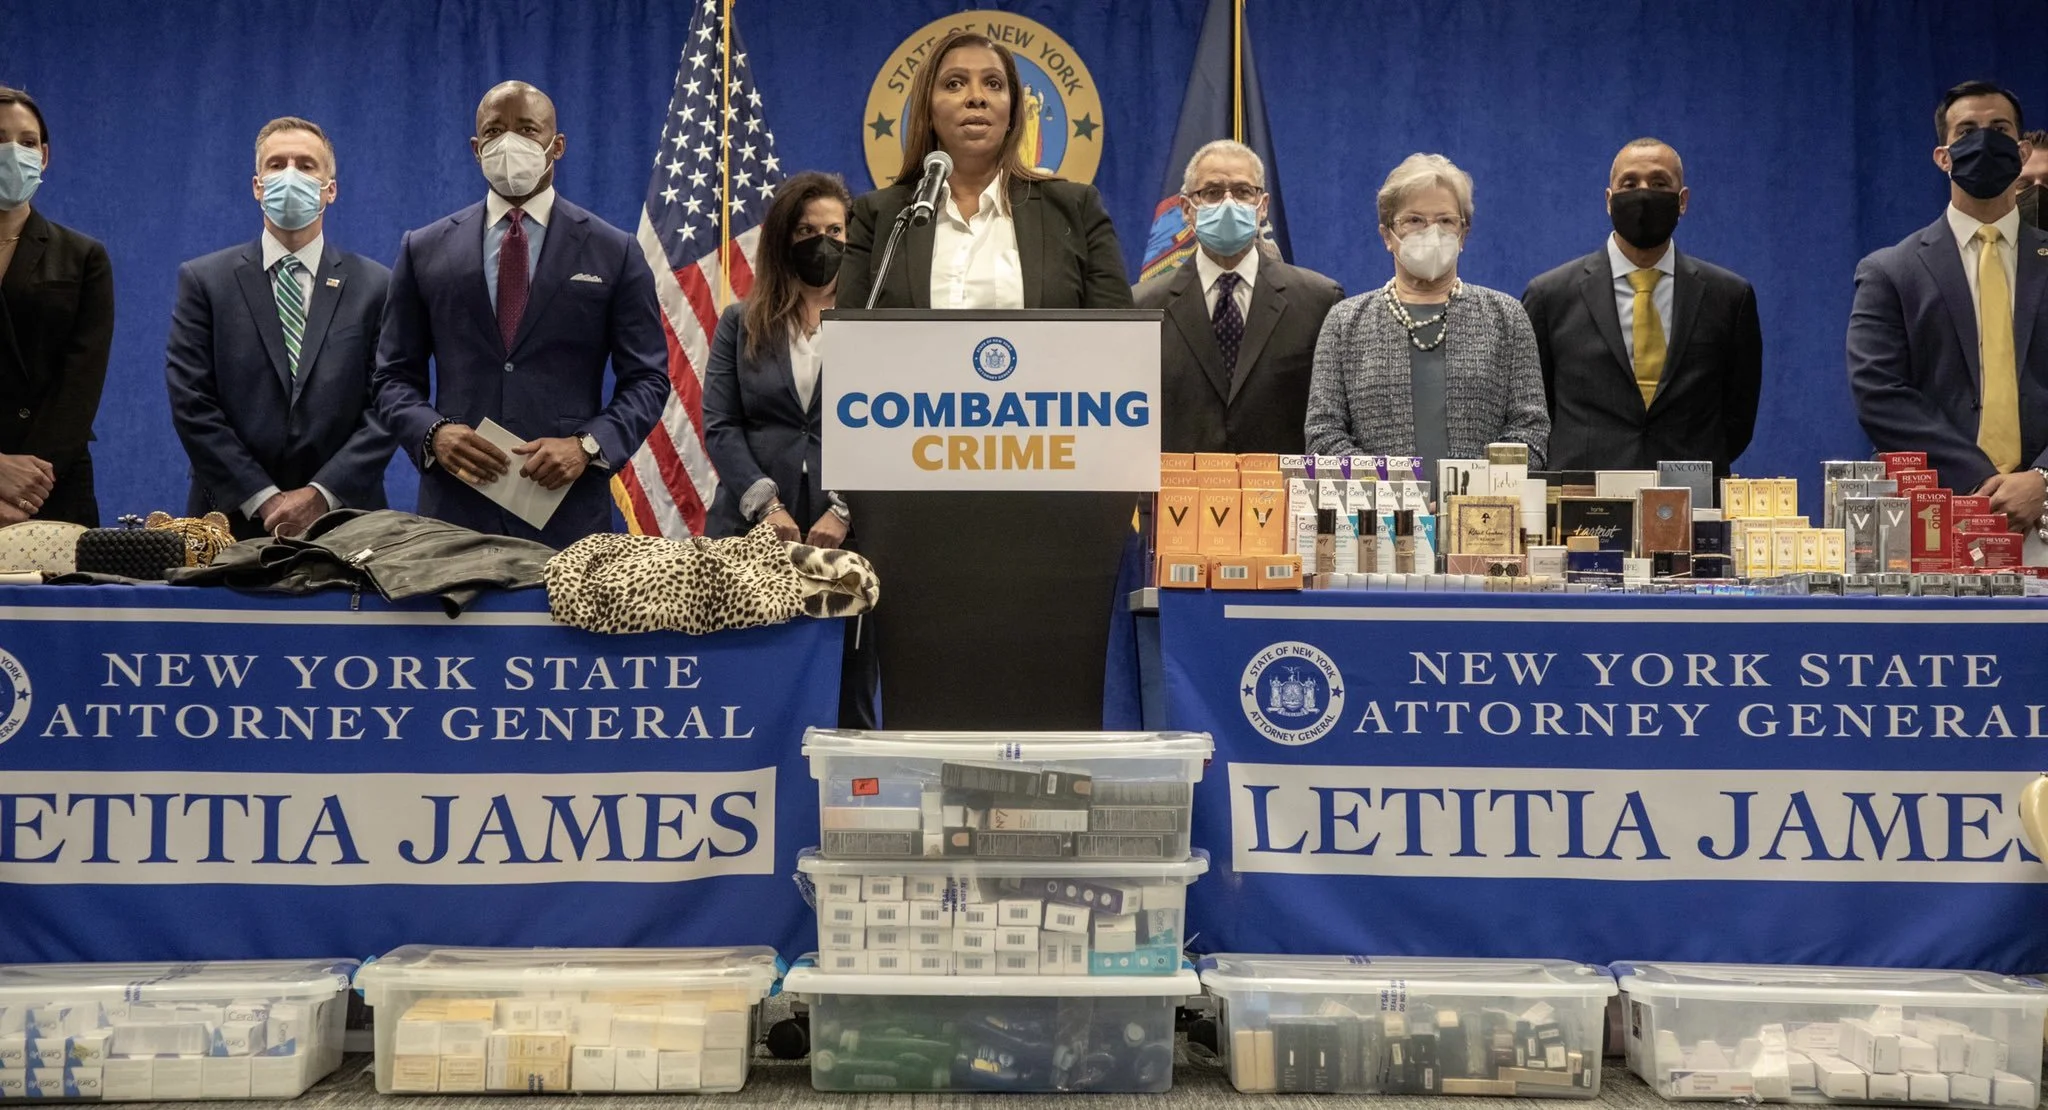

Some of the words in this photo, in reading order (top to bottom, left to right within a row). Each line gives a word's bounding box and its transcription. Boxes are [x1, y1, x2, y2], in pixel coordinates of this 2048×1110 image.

[887, 36, 937, 94] STAT
[987, 23, 1035, 49] NEW
[1038, 42, 1084, 97] YORK
[836, 390, 1149, 429] COMBATING
[911, 434, 1076, 472] CRIME
[1161, 459, 1188, 467] VICHY
[1201, 459, 1233, 467] VICHY
[1244, 460, 1273, 468] VICHY
[1282, 457, 1313, 466] CeraVe
[1317, 457, 1349, 467] CeraVe
[1353, 458, 1384, 467] CeraVe
[1389, 458, 1420, 468] CeraVe
[1162, 477, 1192, 485] VICHY
[1291, 487, 1315, 496] CeraVe
[1321, 488, 1345, 497] CeraVe
[1348, 488, 1372, 497] CeraVe
[1378, 490, 1401, 498] CeraVe
[1404, 489, 1428, 498] CeraVe
[1164, 495, 1193, 503] VICHY
[1206, 495, 1235, 503] VICHY
[1248, 496, 1277, 504] VICHY
[1299, 522, 1317, 531] Cera
[1249, 652, 1274, 677] STATE
[1275, 646, 1289, 656] OF
[1292, 646, 1314, 658] NEW
[1315, 655, 1337, 679] YORK
[1, 656, 23, 681] YORK
[101, 652, 259, 688] NEW
[284, 654, 476, 691] YORK
[504, 655, 702, 691] STATE
[1408, 651, 1558, 686] NEW
[1581, 652, 1772, 687] YORK
[1799, 653, 2002, 688] STATE
[39, 703, 414, 741] ATTORNEY
[441, 705, 755, 741] GENERAL
[1352, 700, 1710, 737] ATTORNEY
[1737, 703, 2048, 738] GENERAL
[0, 718, 20, 738] ERAL
[1249, 710, 1295, 741] ATTORNEY
[1298, 714, 1336, 741] GENERAL
[1243, 784, 1671, 861] LETITIA
[0, 793, 370, 865] ETITIA
[398, 791, 759, 865] JAMES
